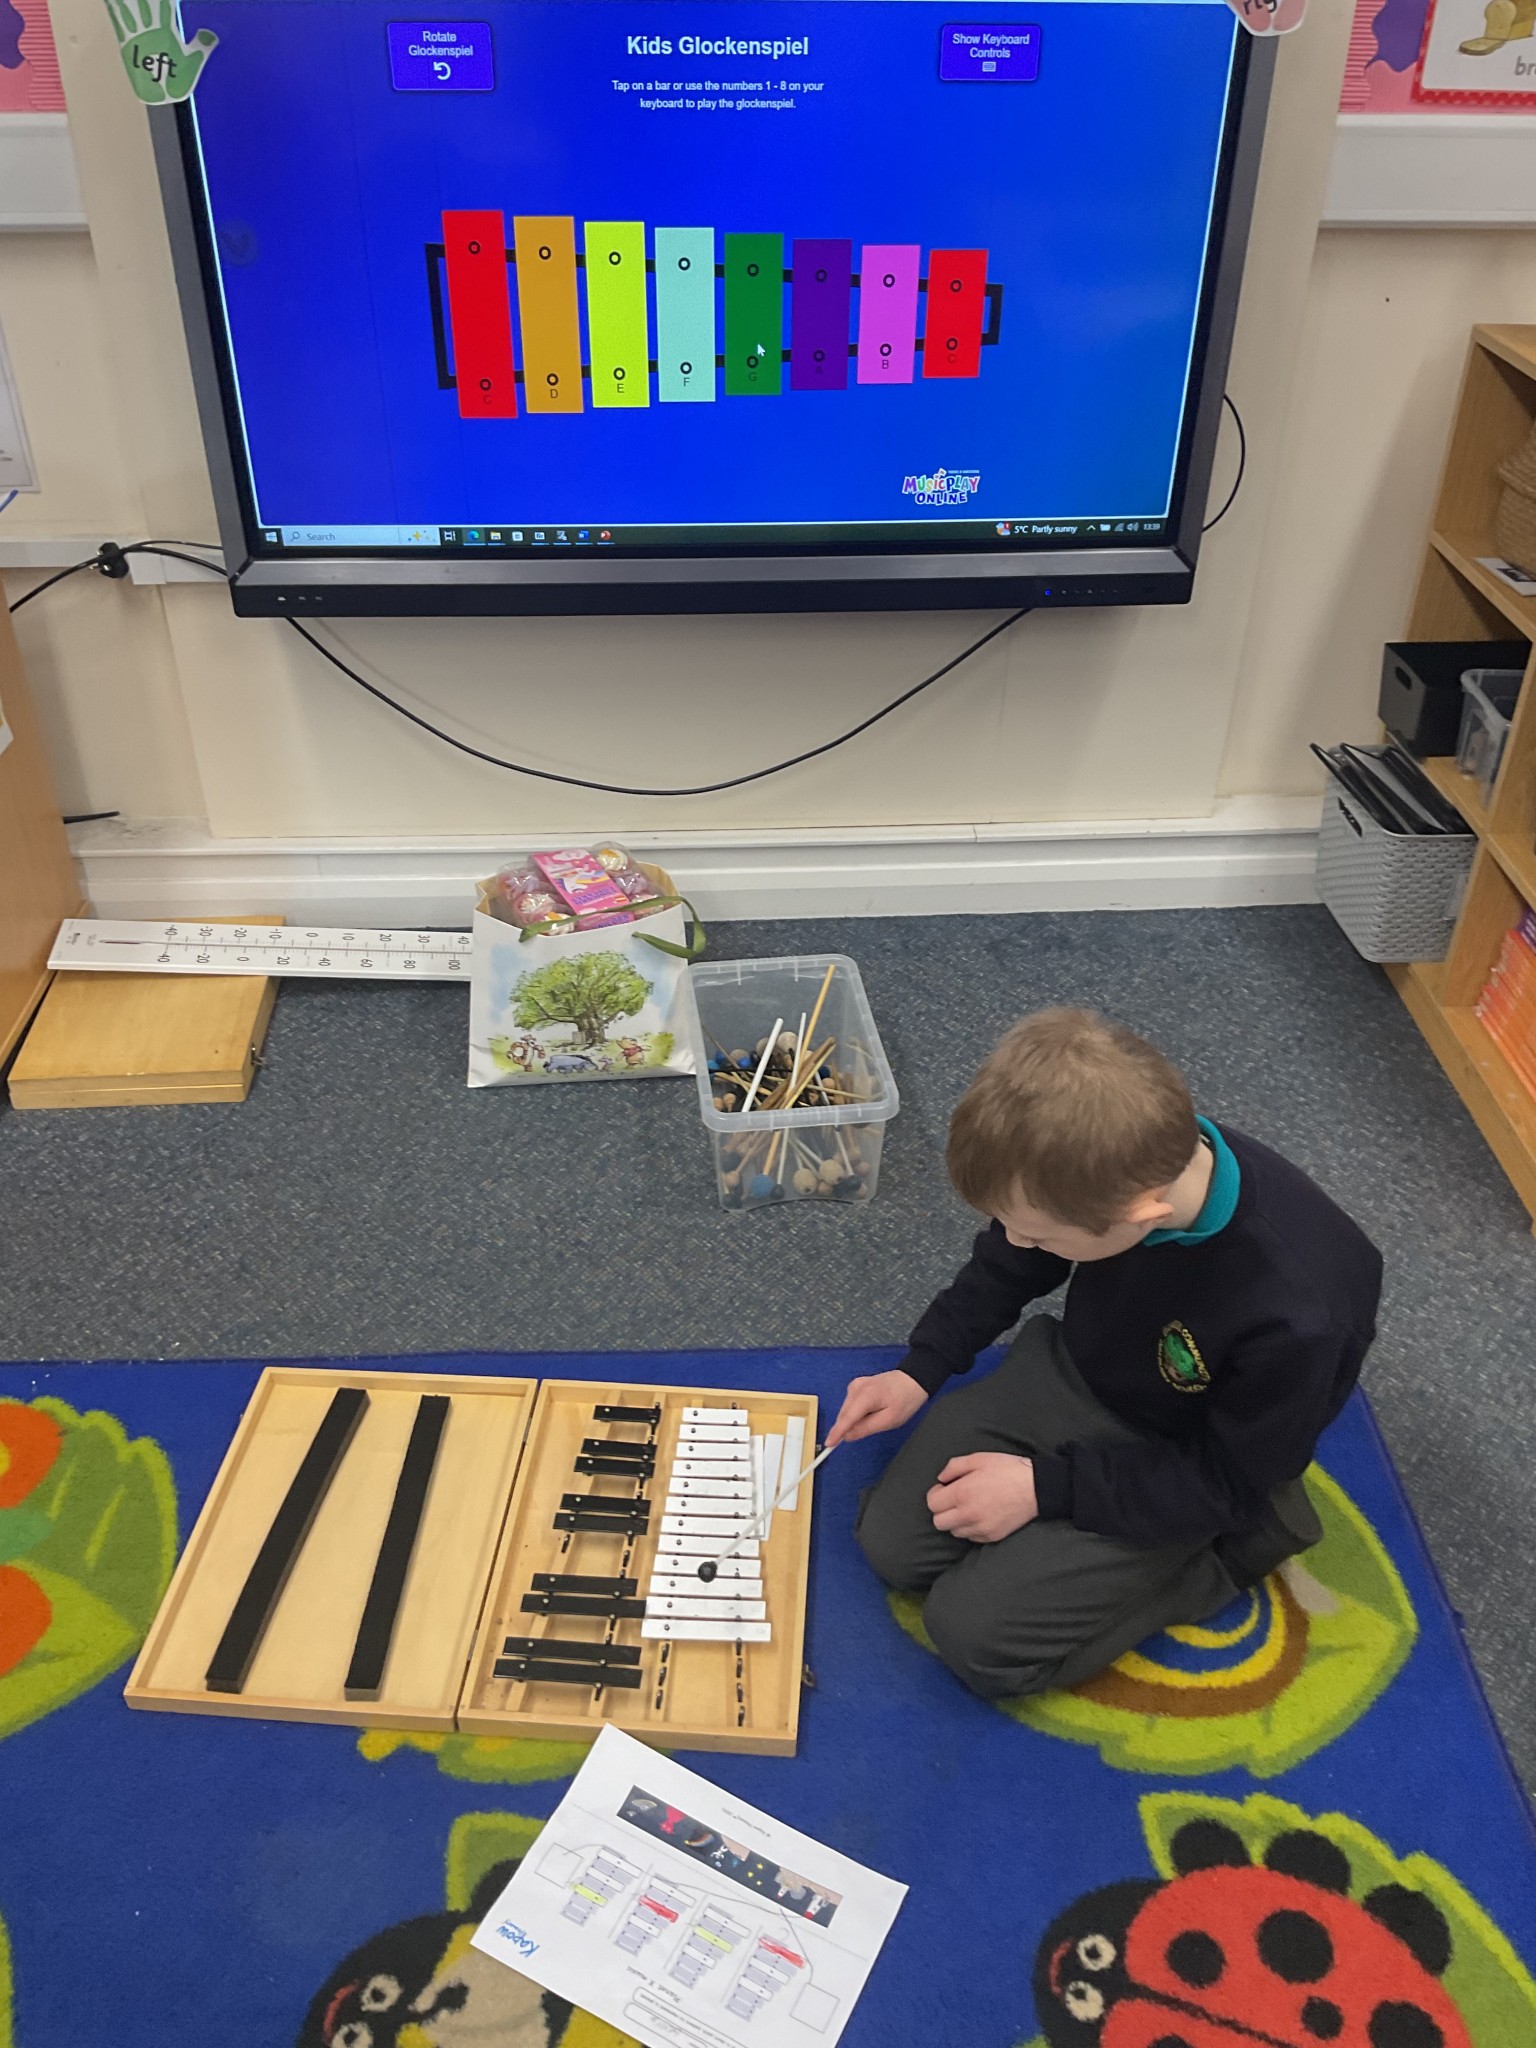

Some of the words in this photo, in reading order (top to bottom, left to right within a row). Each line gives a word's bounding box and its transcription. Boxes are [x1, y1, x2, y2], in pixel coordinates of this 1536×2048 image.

[422, 31, 456, 42] Rotate
[952, 33, 980, 44] Show
[983, 34, 1030, 46] Keyboard
[408, 45, 474, 58] Glockenspiel
[627, 36, 672, 55] Kids
[678, 36, 809, 60] Glockenspiel
[970, 47, 1011, 58] Controls
[133, 44, 177, 82] left
[612, 80, 629, 92] Tap
[655, 81, 670, 91] bar
[673, 83, 683, 91] or
[685, 83, 702, 91] use
[704, 81, 720, 91] the
[722, 81, 763, 91] numbers
[766, 81, 771, 90] 1
[780, 81, 787, 91] 8
[789, 83, 801, 91] on
[803, 83, 824, 93] your
[640, 98, 683, 110] keyboard
[686, 99, 695, 108] to
[697, 98, 717, 110] play
[719, 98, 734, 108] the
[736, 98, 796, 110] glockenspiel.
[815, 365, 824, 375] A
[881, 359, 889, 370] B
[683, 377, 690, 387] F
[748, 371, 758, 382] G
[550, 388, 559, 399] D
[616, 383, 625, 394] E
[915, 492, 967, 505] ONLINE
[1014, 525, 1028, 533] 5°C
[1032, 525, 1053, 534] Partly
[1054, 526, 1078, 534] sunny
[307, 533, 336, 541] Search
[200, 926, 212, 937] -30
[234, 927, 247, 938] -20
[269, 929, 282, 940] -10
[342, 933, 355, 941] 10
[380, 933, 392, 942] 20
[418, 935, 430, 944] 30
[458, 936, 470, 945] 40
[196, 953, 210, 964] -20
[277, 956, 290, 966] 20
[318, 957, 331, 967] 40
[360, 958, 373, 968] 60
[403, 960, 416, 969] 80
[448, 959, 461, 971] 100
[496, 1925, 540, 1958] Kapow
